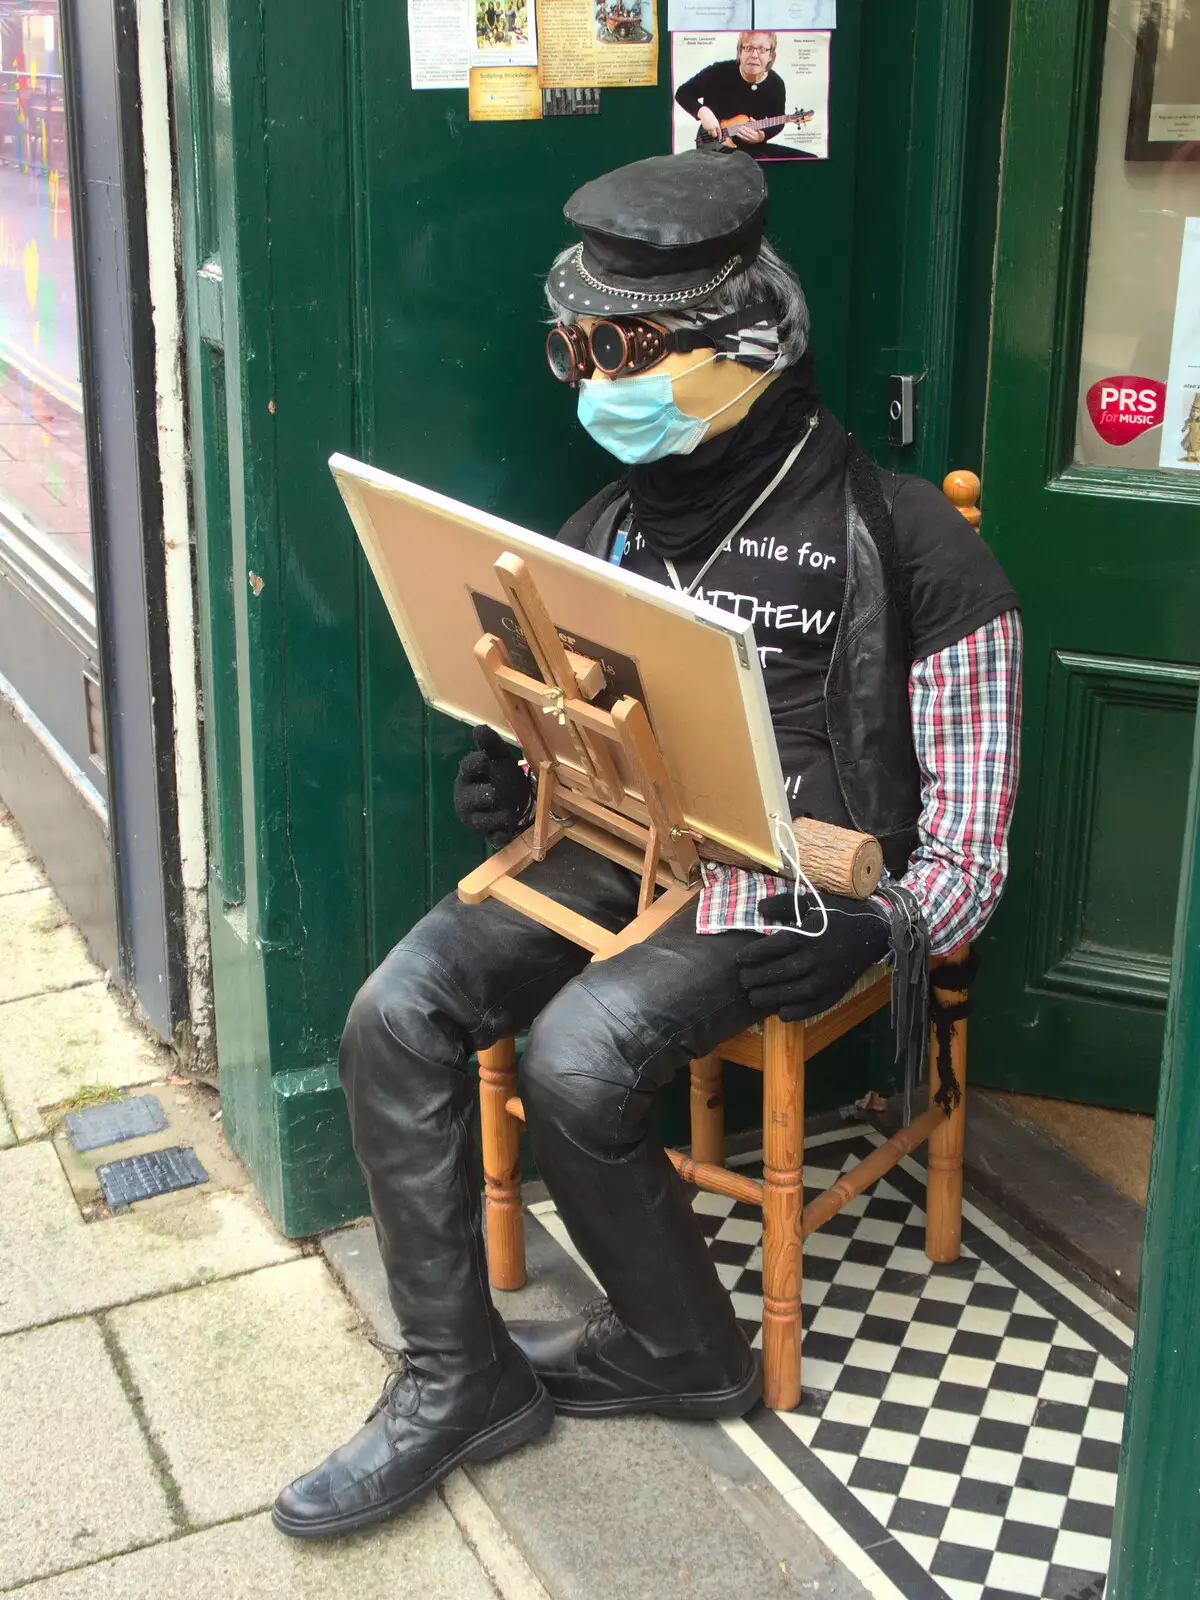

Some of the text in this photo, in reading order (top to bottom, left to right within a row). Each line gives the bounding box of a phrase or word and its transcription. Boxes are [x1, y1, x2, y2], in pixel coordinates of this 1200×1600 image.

[1100, 388, 1157, 413] PRS
[1100, 411, 1154, 425] for MUSIC
[739, 537, 788, 561] mile
[797, 542, 836, 570] for
